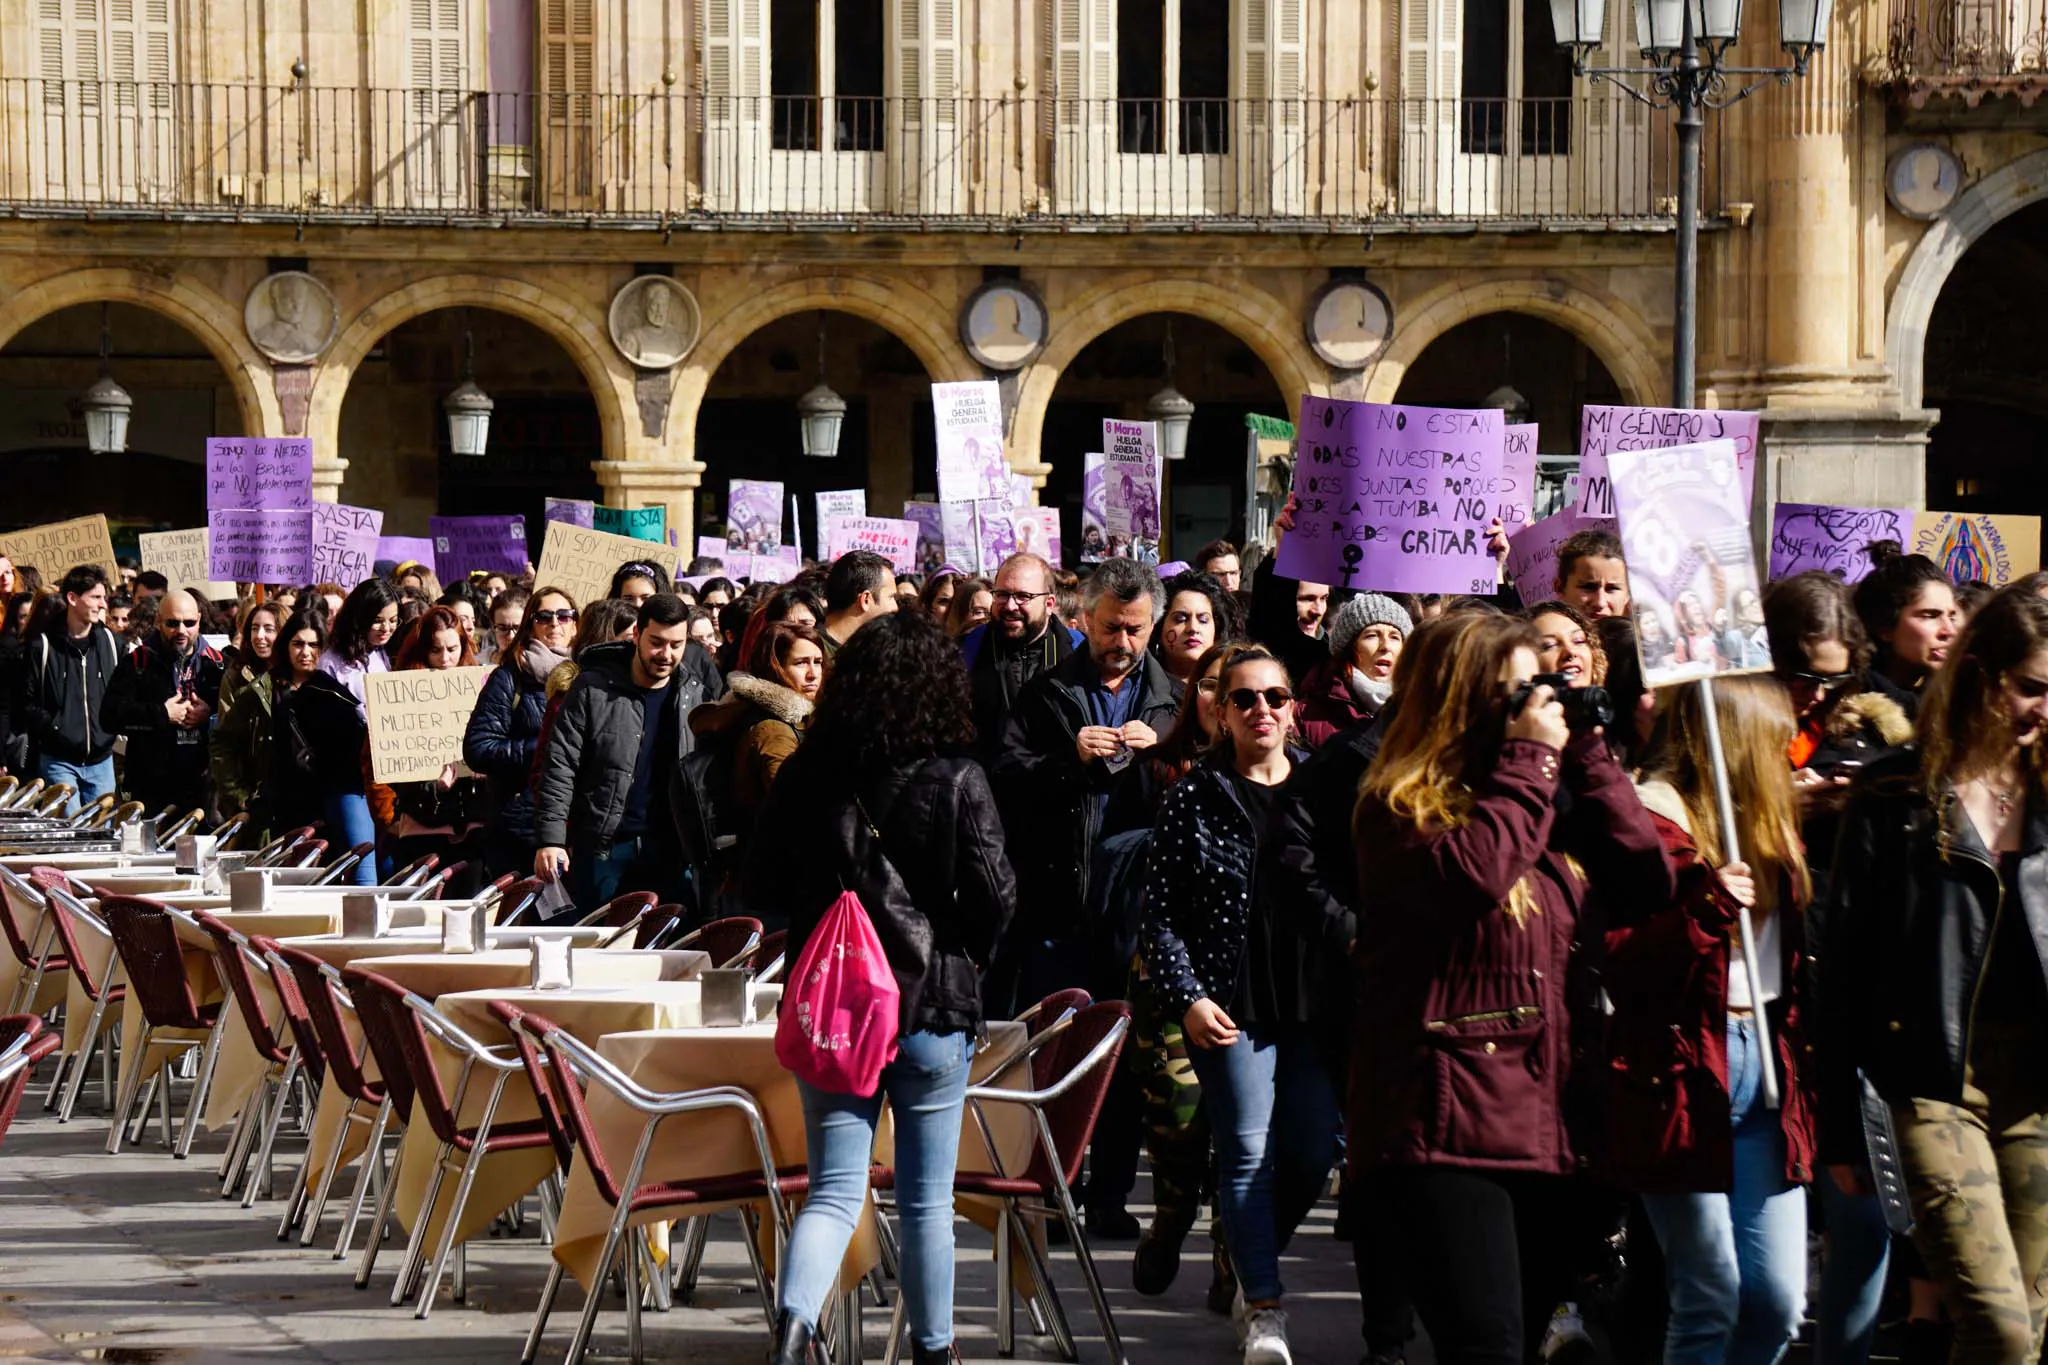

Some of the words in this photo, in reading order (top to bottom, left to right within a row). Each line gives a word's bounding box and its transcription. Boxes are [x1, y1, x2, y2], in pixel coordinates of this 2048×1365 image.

[952, 408, 986, 416] GENERAL
[1377, 408, 1408, 431] NO
[1105, 422, 1111, 433] 8
[1114, 422, 1142, 436] Marzo
[1113, 446, 1142, 455] GENERAL
[1116, 436, 1142, 446] HUELGA
[1109, 454, 1143, 463] ESTUDIANTIL
[1305, 440, 1360, 468] TODAS
[1377, 448, 1481, 472] NUESTRAS
[1301, 477, 1343, 496] VOCES
[1359, 476, 1427, 497] JUNTAS
[1444, 477, 1497, 496] PORQUE
[1340, 501, 1363, 517] LA
[1374, 499, 1440, 518] TUMBA
[1455, 498, 1486, 522] NO
[36, 527, 80, 548] QUIERO
[82, 523, 105, 541] TU
[323, 527, 348, 547] DE
[550, 527, 568, 548] NI
[574, 533, 602, 554] SOY
[1332, 520, 1388, 543] PUEDE
[66, 543, 103, 563] QUIERO
[144, 550, 178, 566] QUIERO
[543, 552, 560, 572] NI
[564, 556, 612, 581] ESTOY
[1470, 579, 1492, 593] 8M
[376, 674, 477, 704] NINGUNA
[381, 711, 443, 733] MUJER
[379, 738, 400, 751] UN
[405, 735, 464, 751] ORGASM
[380, 755, 440, 776] LIMPIANDO
